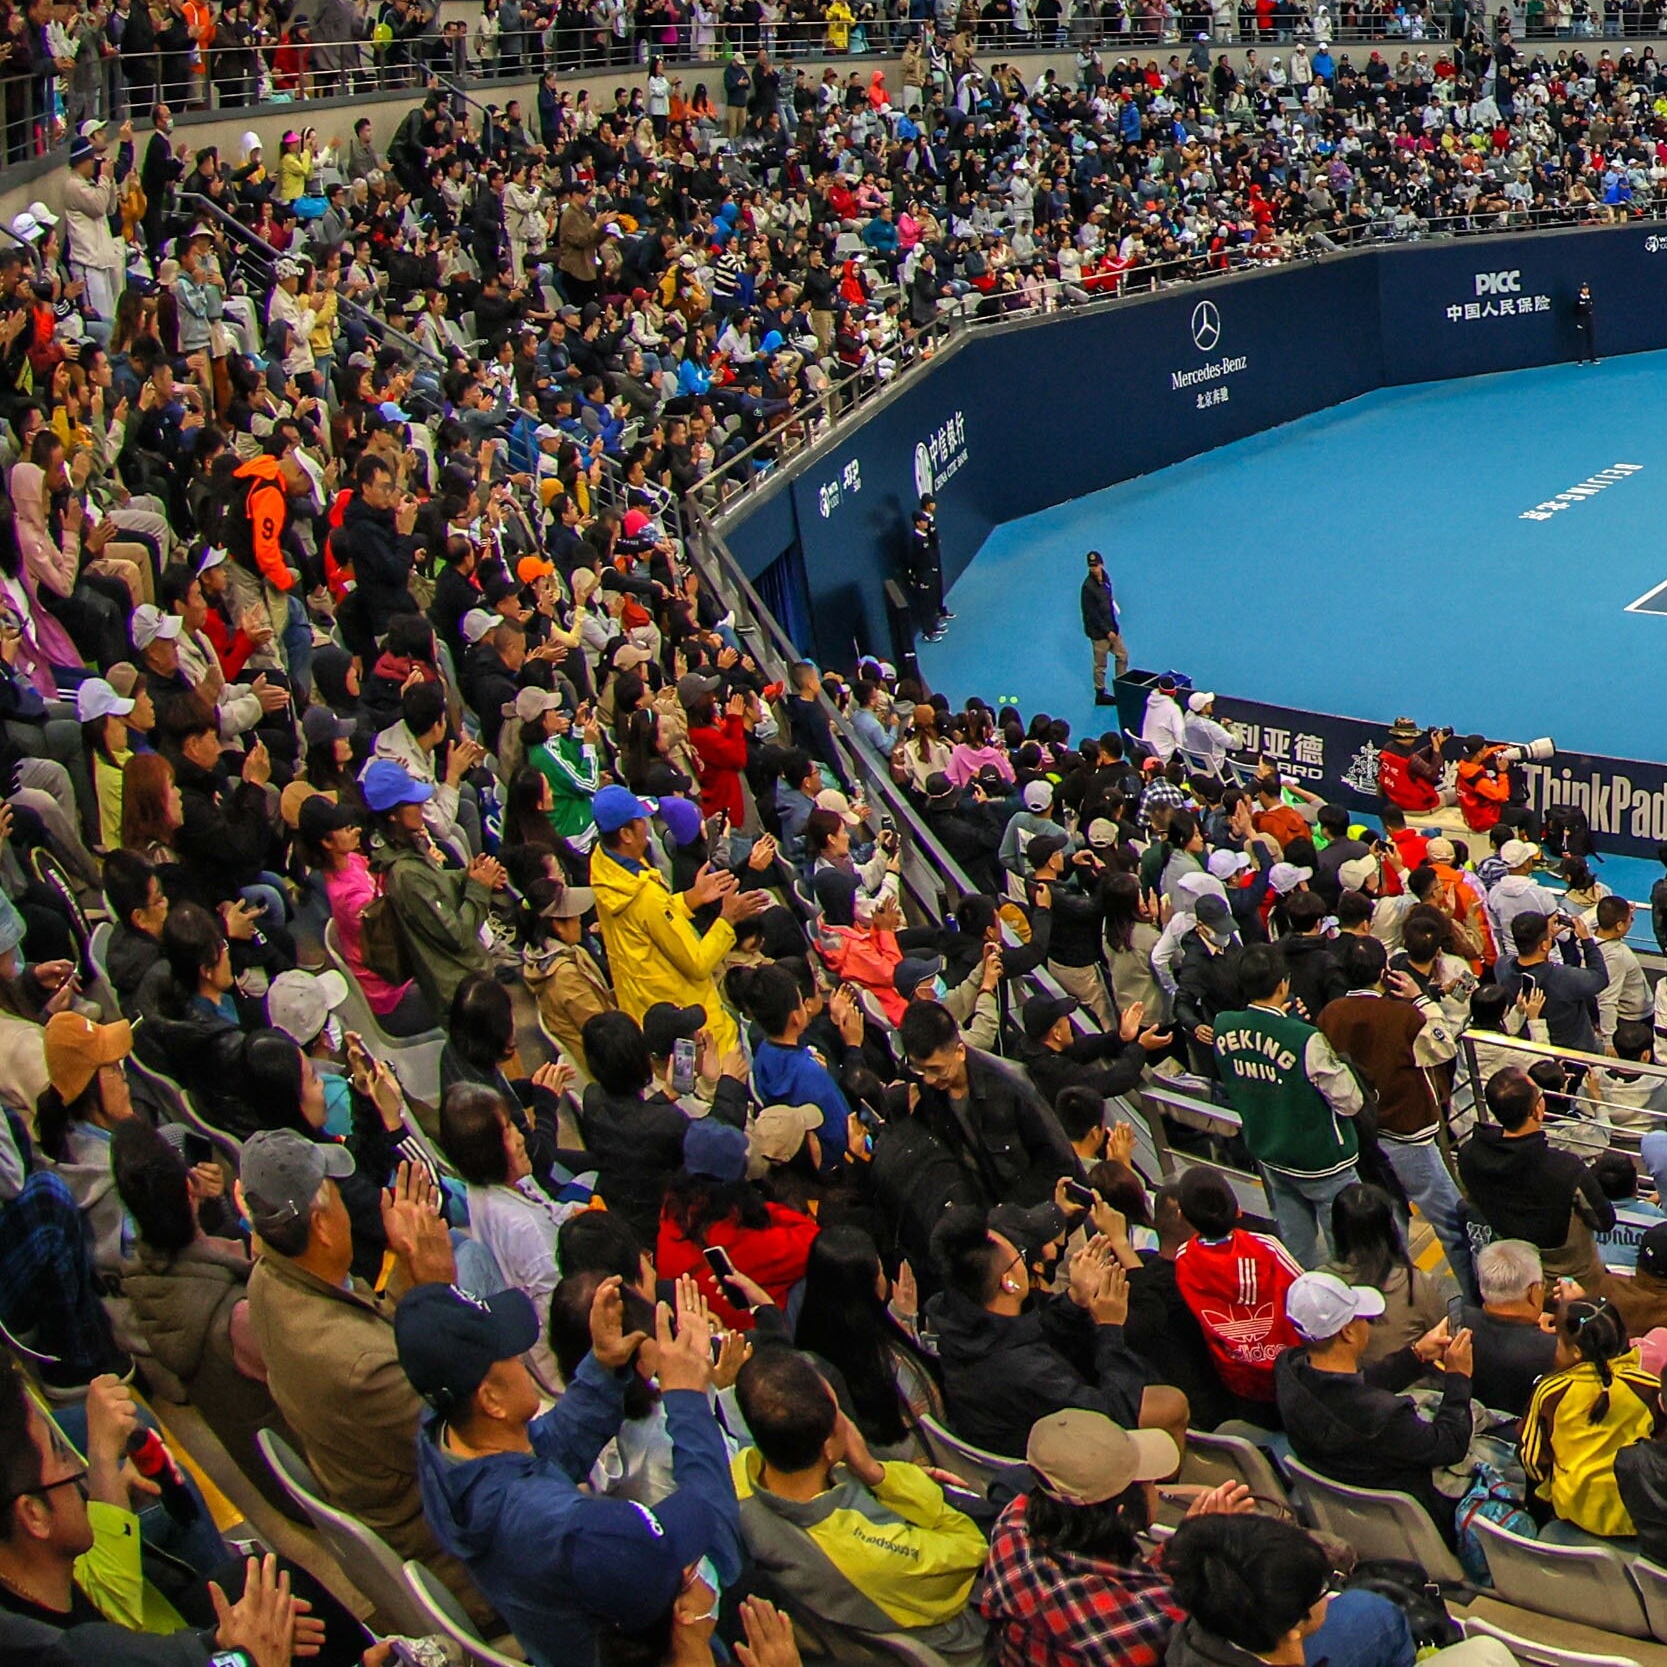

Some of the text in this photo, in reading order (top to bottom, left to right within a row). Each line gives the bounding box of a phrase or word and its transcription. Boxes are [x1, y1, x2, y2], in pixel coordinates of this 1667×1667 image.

[1475, 270, 1521, 296] PICC
[1446, 295, 1551, 322] 中国人民保险
[1171, 355, 1248, 391] Mercedes-Benz
[1196, 385, 1229, 409] 北京奔驰
[929, 411, 966, 471] 中信银行
[262, 518, 274, 540] 9
[1231, 721, 1324, 766] 利亚德
[1216, 1029, 1297, 1071] PEKING
[1232, 1058, 1284, 1085] UNIV.
